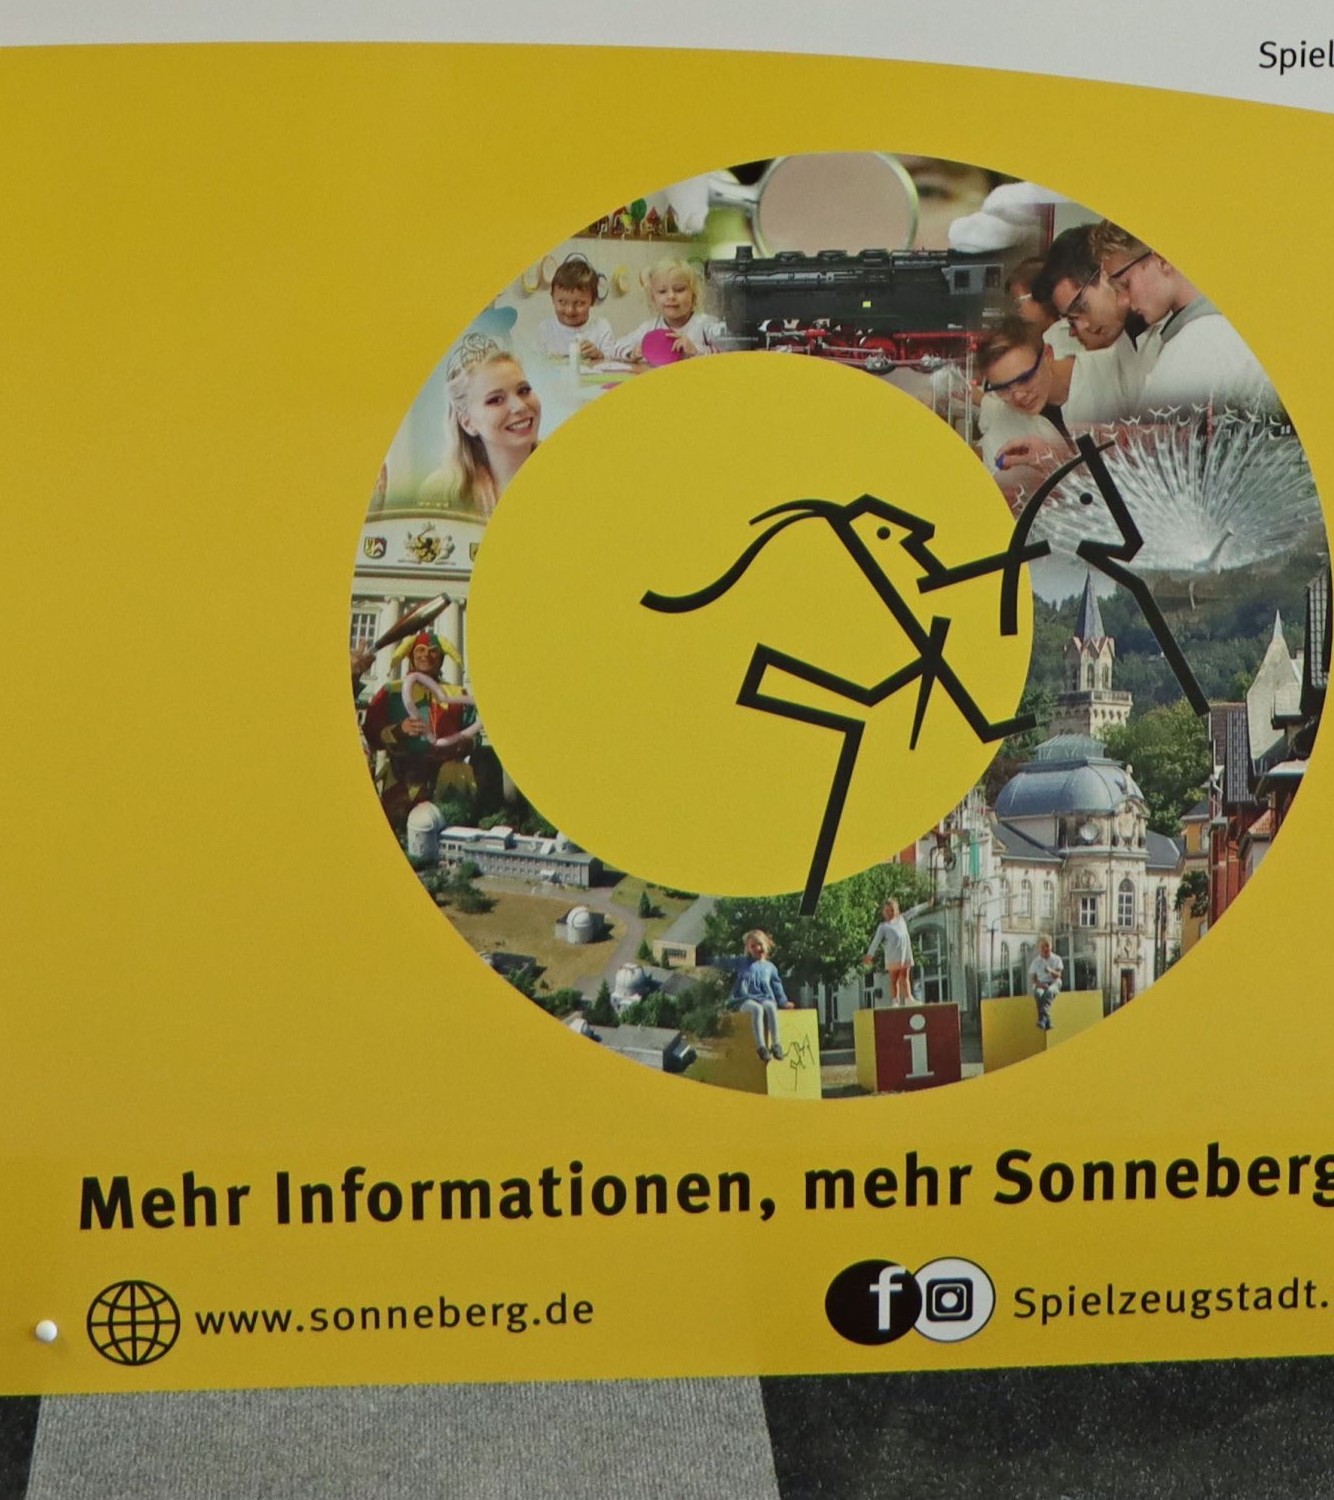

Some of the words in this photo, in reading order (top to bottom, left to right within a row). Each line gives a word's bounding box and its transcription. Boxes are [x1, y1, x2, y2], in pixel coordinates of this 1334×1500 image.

[79, 1172, 252, 1231] Mehr
[276, 1160, 777, 1225] Informationen,
[804, 1150, 973, 1211] mehr
[194, 1291, 595, 1335] www.sonneberg.de
